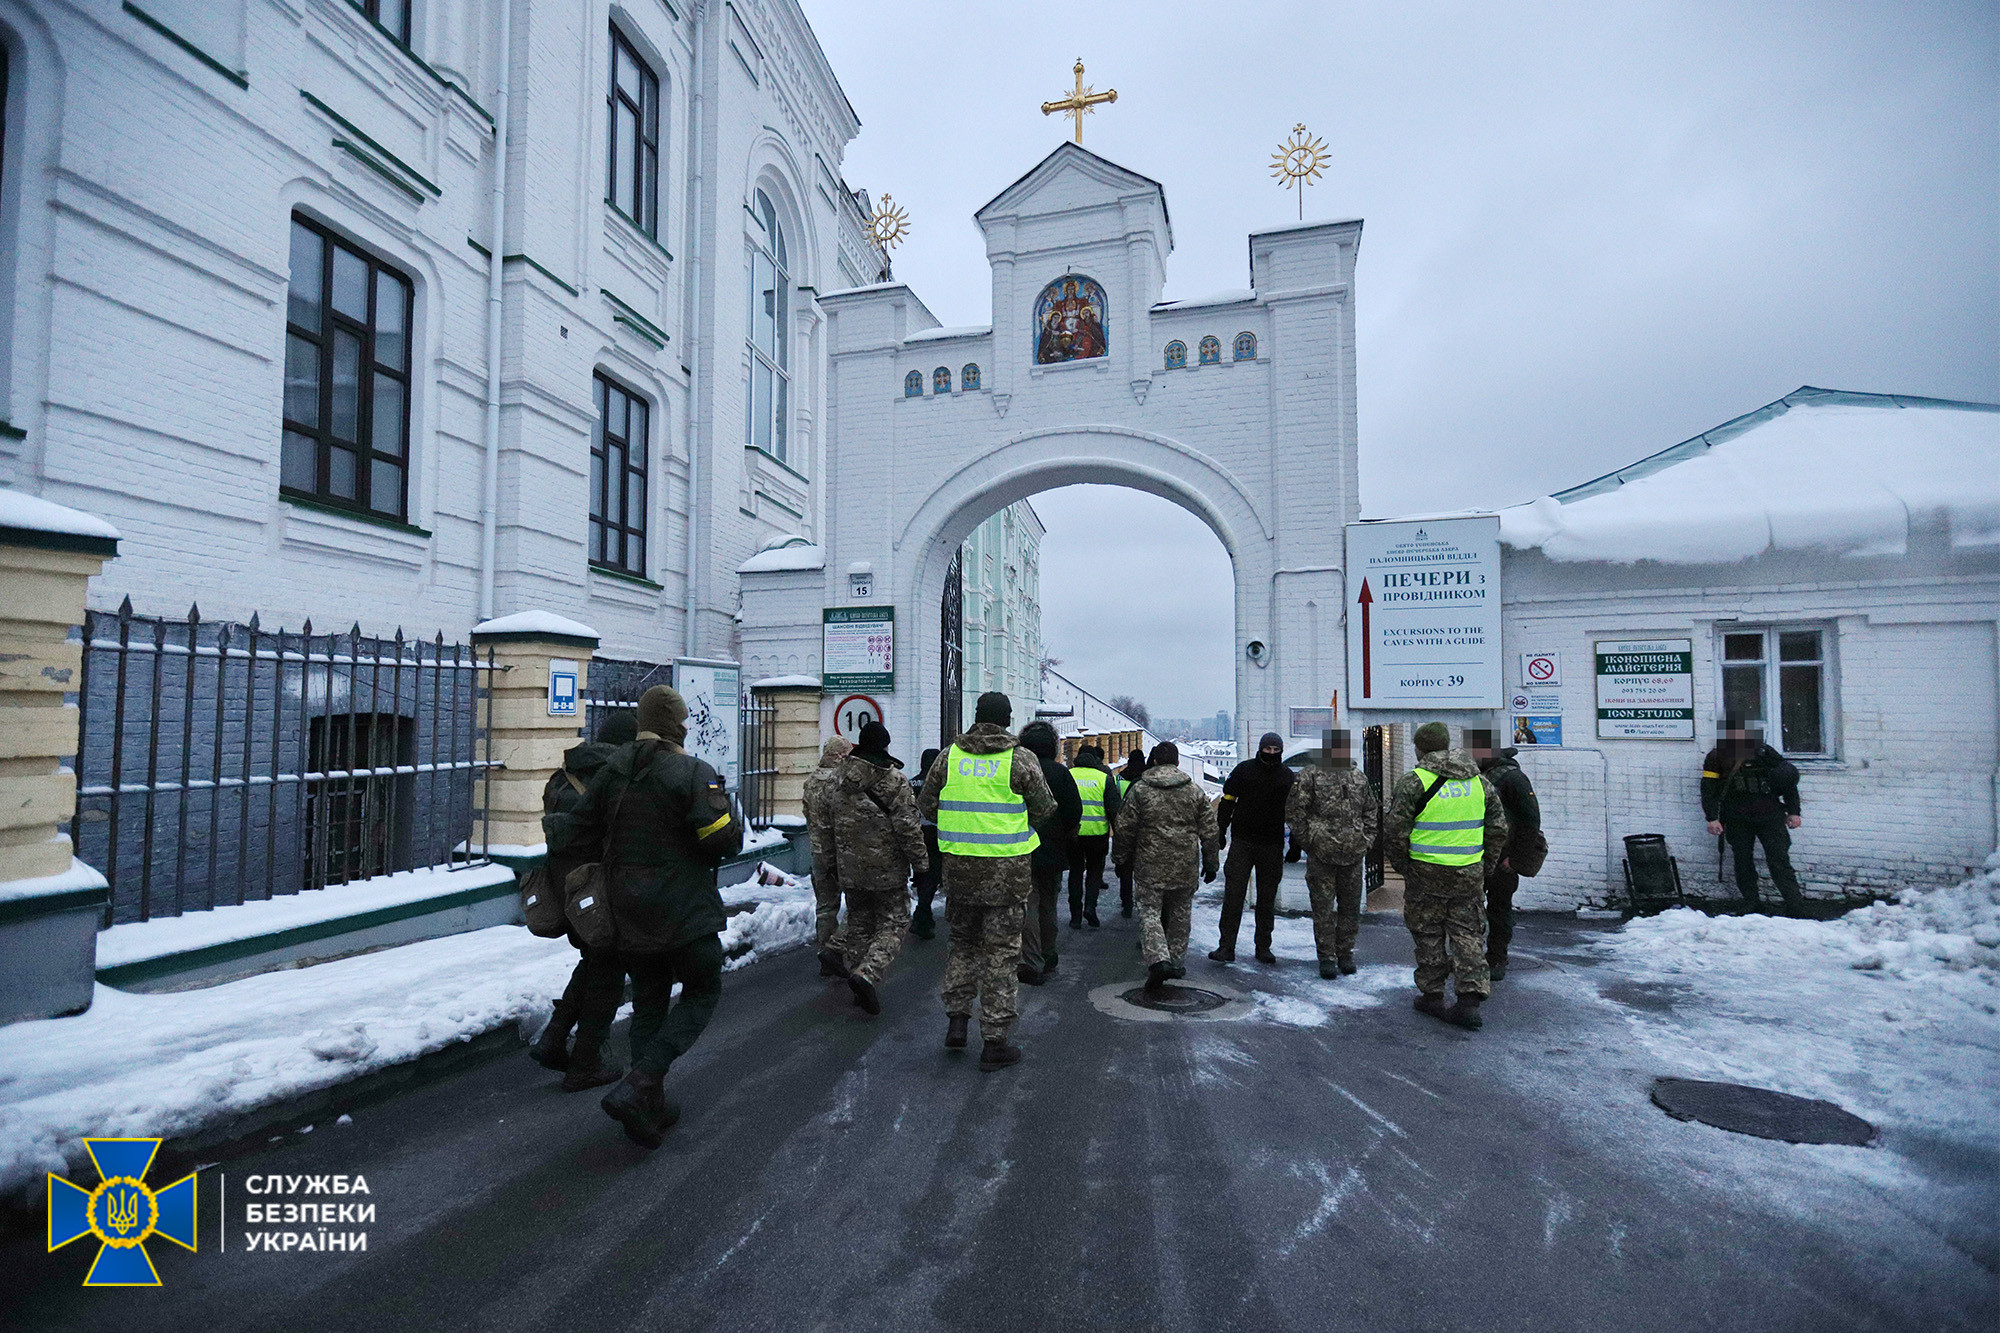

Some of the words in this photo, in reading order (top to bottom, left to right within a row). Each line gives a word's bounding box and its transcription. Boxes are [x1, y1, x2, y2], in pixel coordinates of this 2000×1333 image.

[1369, 554, 1445, 564] ПАЛОМНИЦЬКИЙ
[1447, 552, 1477, 561] ВІДДІЛ
[1384, 570, 1471, 588] ПЕЧЕРИ
[856, 586, 868, 595] 15
[1383, 589, 1486, 602] ПРОВІДНИКОМ
[1383, 628, 1445, 636] EXCURSIONS
[1448, 627, 1461, 635] TO
[1463, 627, 1484, 635] THE
[1383, 638, 1415, 647] CAVES
[1416, 638, 1443, 646] WITH
[1453, 637, 1486, 645] GUIDE
[1605, 654, 1681, 664] ІКОНОПИСНА
[1605, 663, 1682, 673] МАЙСТЕРНЯ
[1400, 679, 1444, 687] КОРПУС
[1447, 675, 1465, 687] 39
[1607, 709, 1635, 718] ICON
[1637, 709, 1683, 718] STUDIO
[845, 711, 871, 731] 10
[958, 757, 1000, 778] СБУ
[1438, 780, 1471, 799] СБУ
